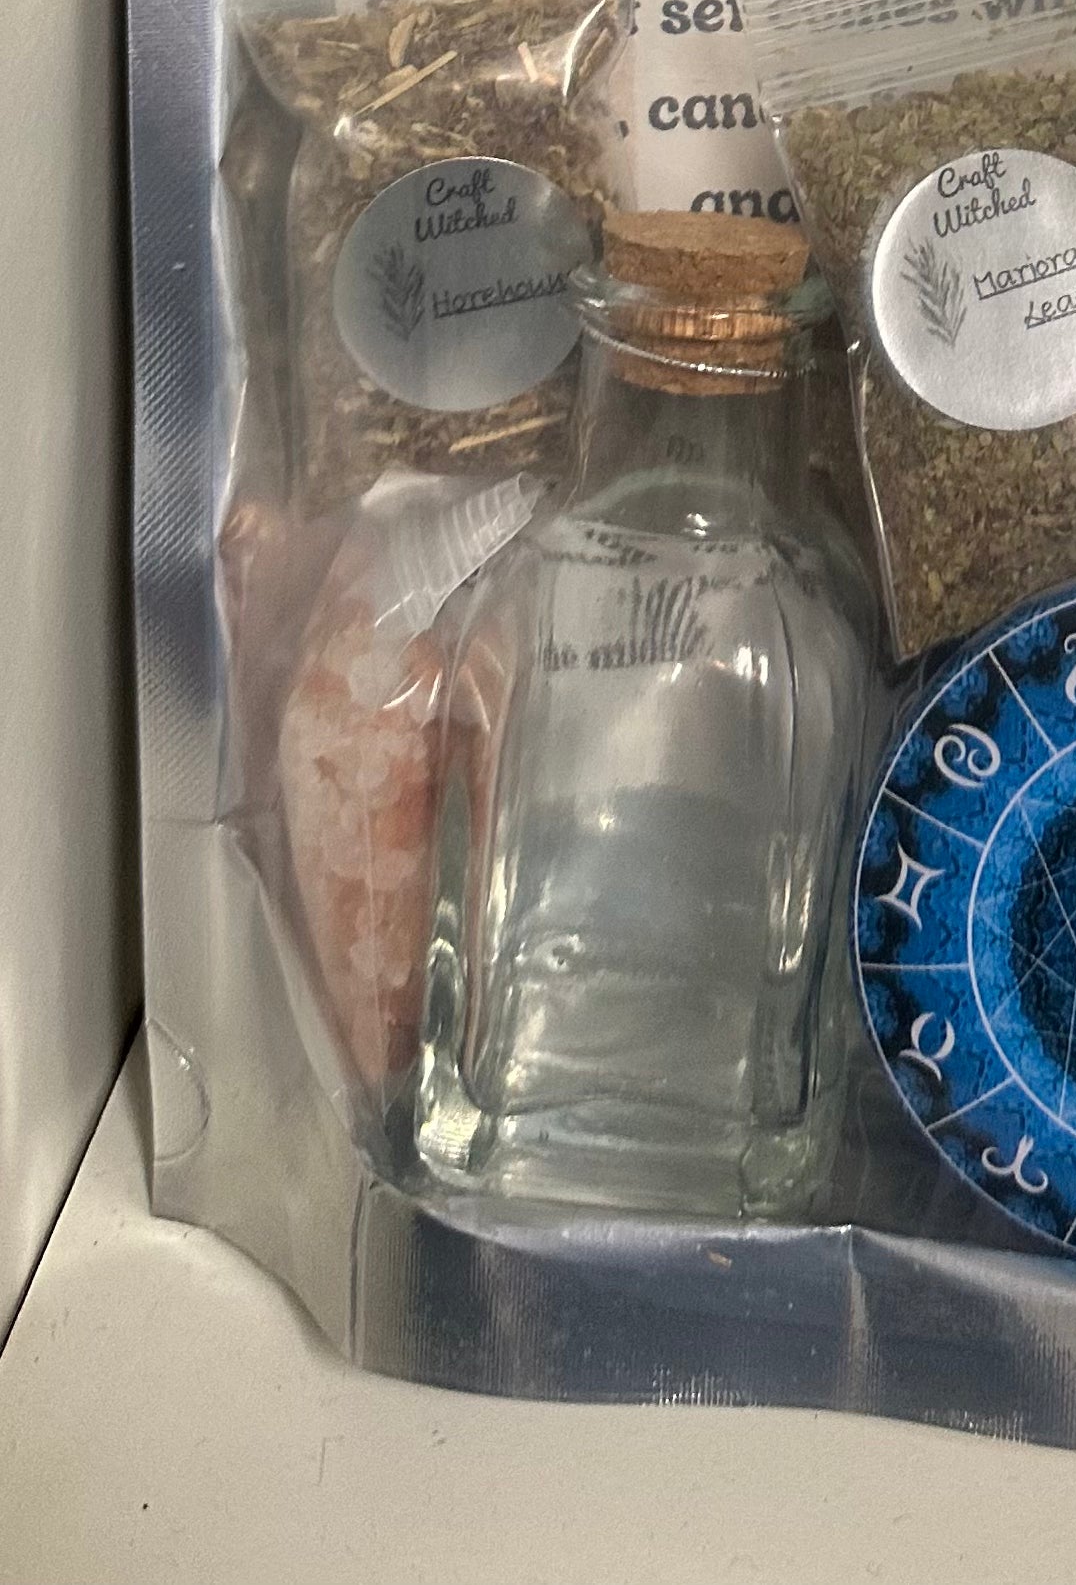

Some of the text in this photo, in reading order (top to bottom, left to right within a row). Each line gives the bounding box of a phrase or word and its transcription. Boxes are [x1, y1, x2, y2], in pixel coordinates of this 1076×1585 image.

[647, 91, 768, 132] can
[426, 168, 496, 208] Craft
[934, 152, 1037, 238] Craft Witched
[432, 269, 572, 316] Horehoun
